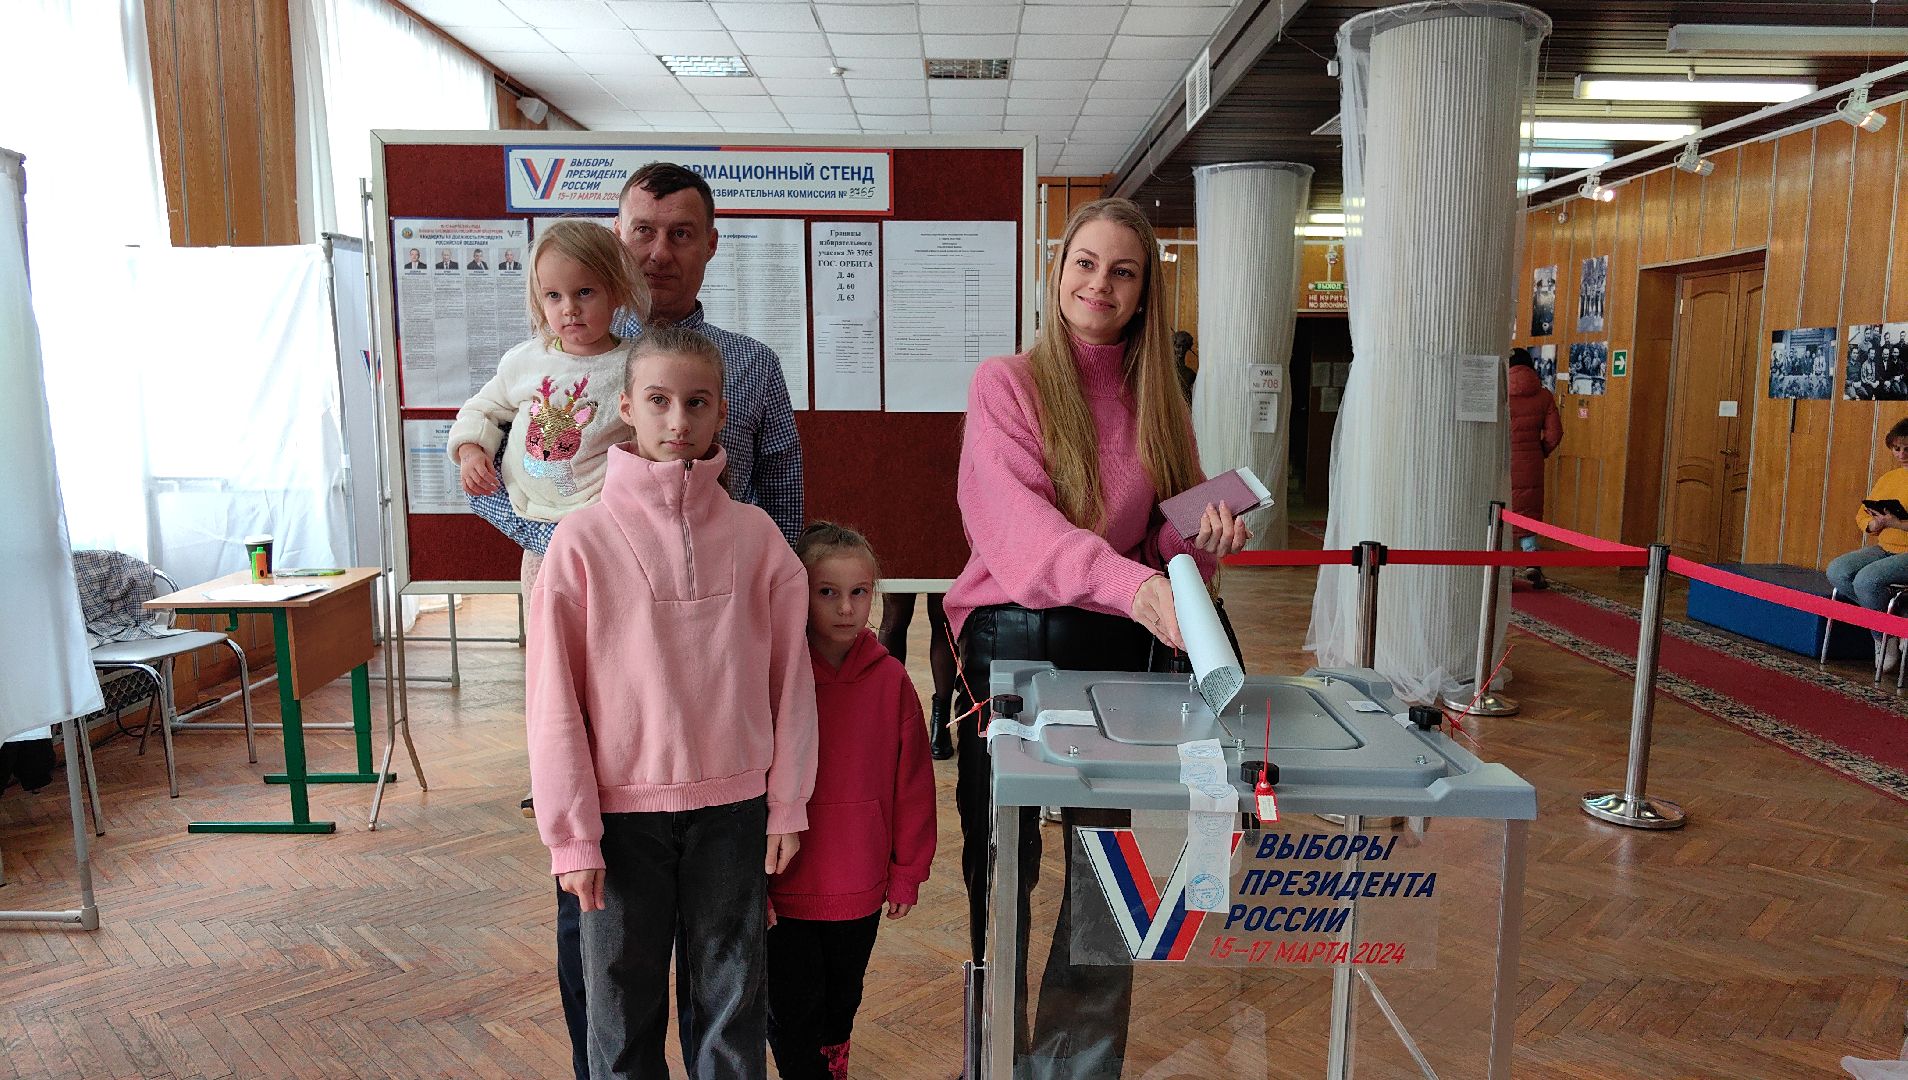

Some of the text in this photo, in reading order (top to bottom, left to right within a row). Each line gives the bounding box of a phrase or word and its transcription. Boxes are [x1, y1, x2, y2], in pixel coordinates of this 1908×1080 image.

[570, 158, 614, 167] ВЫБОРЫ
[565, 170, 627, 181] ПРЕЗИДЕНТА
[819, 165, 875, 184] СТЕНД
[561, 181, 601, 191] РОССИИ
[577, 192, 602, 200] МАРТА
[787, 189, 836, 199] КОМИССИЯ
[838, 190, 847, 198] №
[830, 229, 861, 237] Границы
[1262, 379, 1279, 389] 708
[1255, 833, 1398, 860] ВЫБОРЫ
[1239, 870, 1437, 900] ПРЕЗИДЕНТА
[1224, 903, 1351, 932] РОССИИ
[1274, 940, 1350, 964] МАРТА
[1351, 942, 1407, 964] 2024
